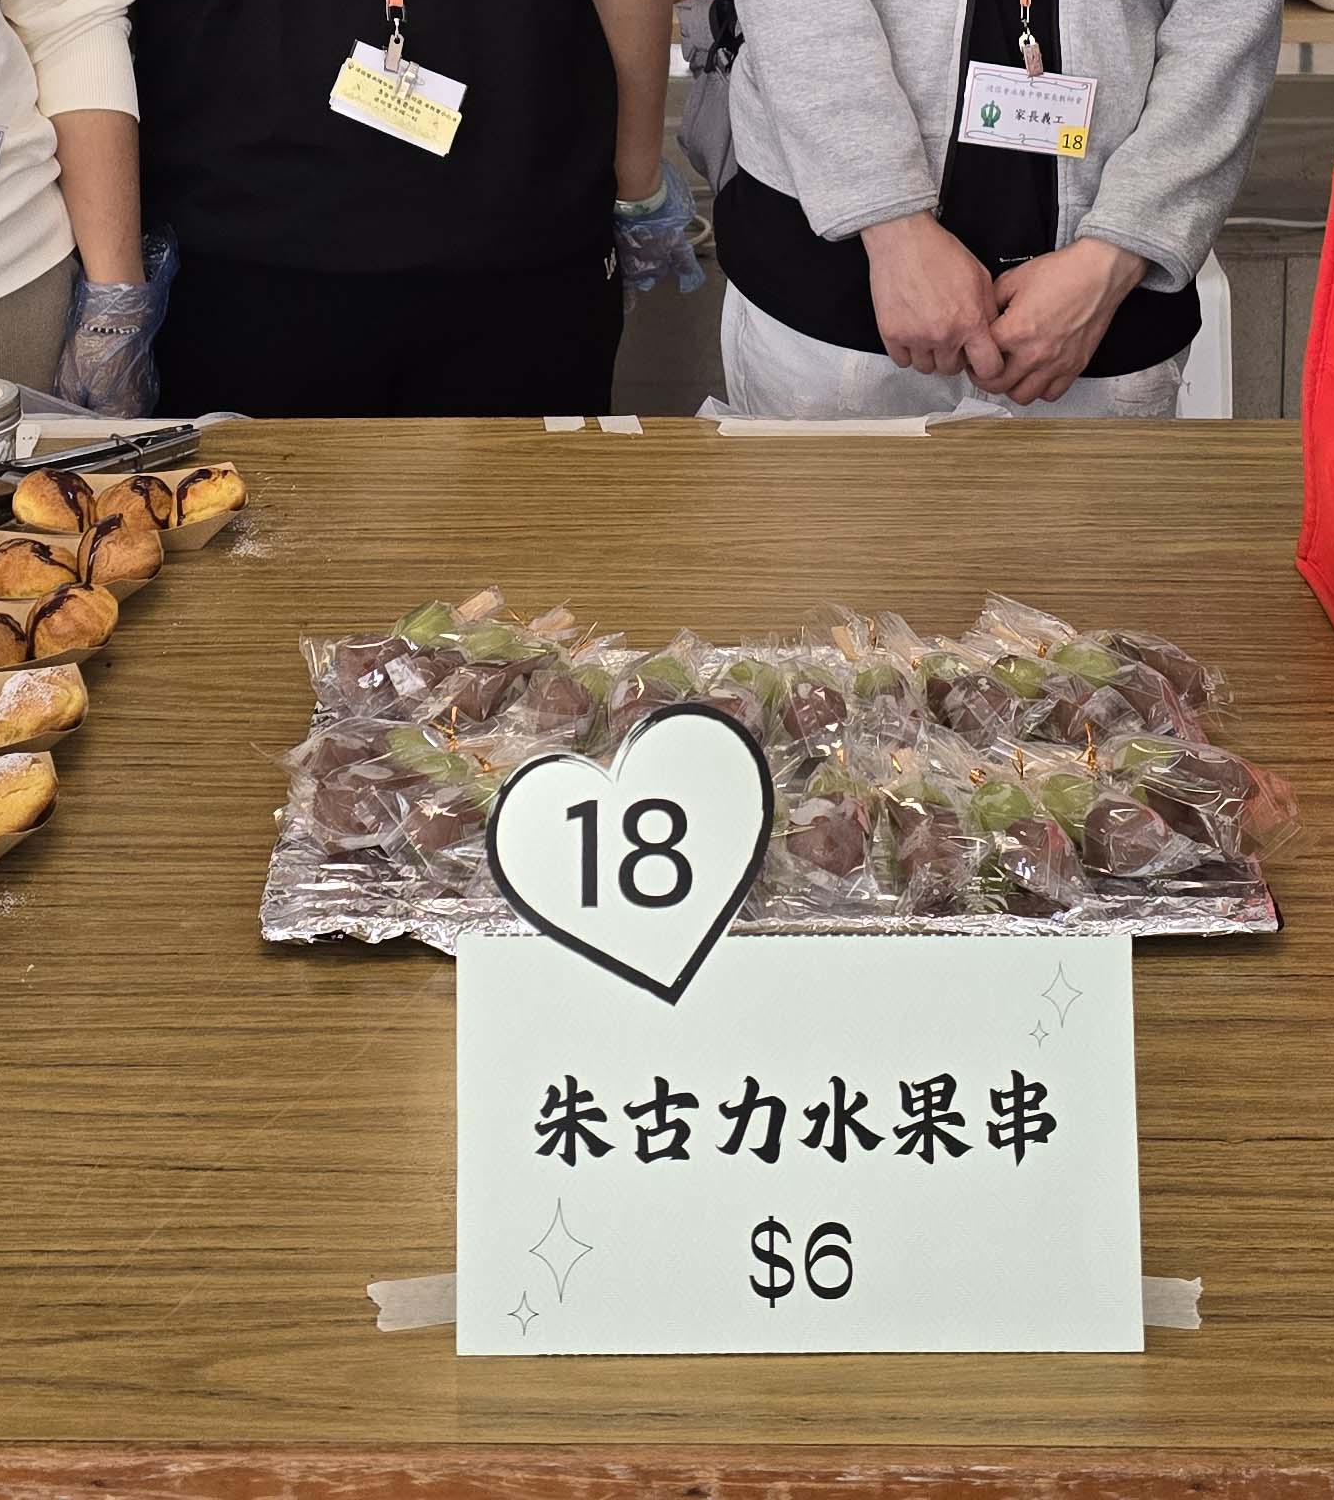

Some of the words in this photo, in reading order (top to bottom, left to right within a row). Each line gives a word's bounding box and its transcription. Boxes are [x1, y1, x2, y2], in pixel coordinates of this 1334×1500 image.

[1015, 108, 1065, 125] 家長義工
[1062, 134, 1083, 150] 18
[565, 798, 695, 911] 18
[533, 1069, 1059, 1167] 朱古力水果串
[749, 1215, 854, 1309] $6
